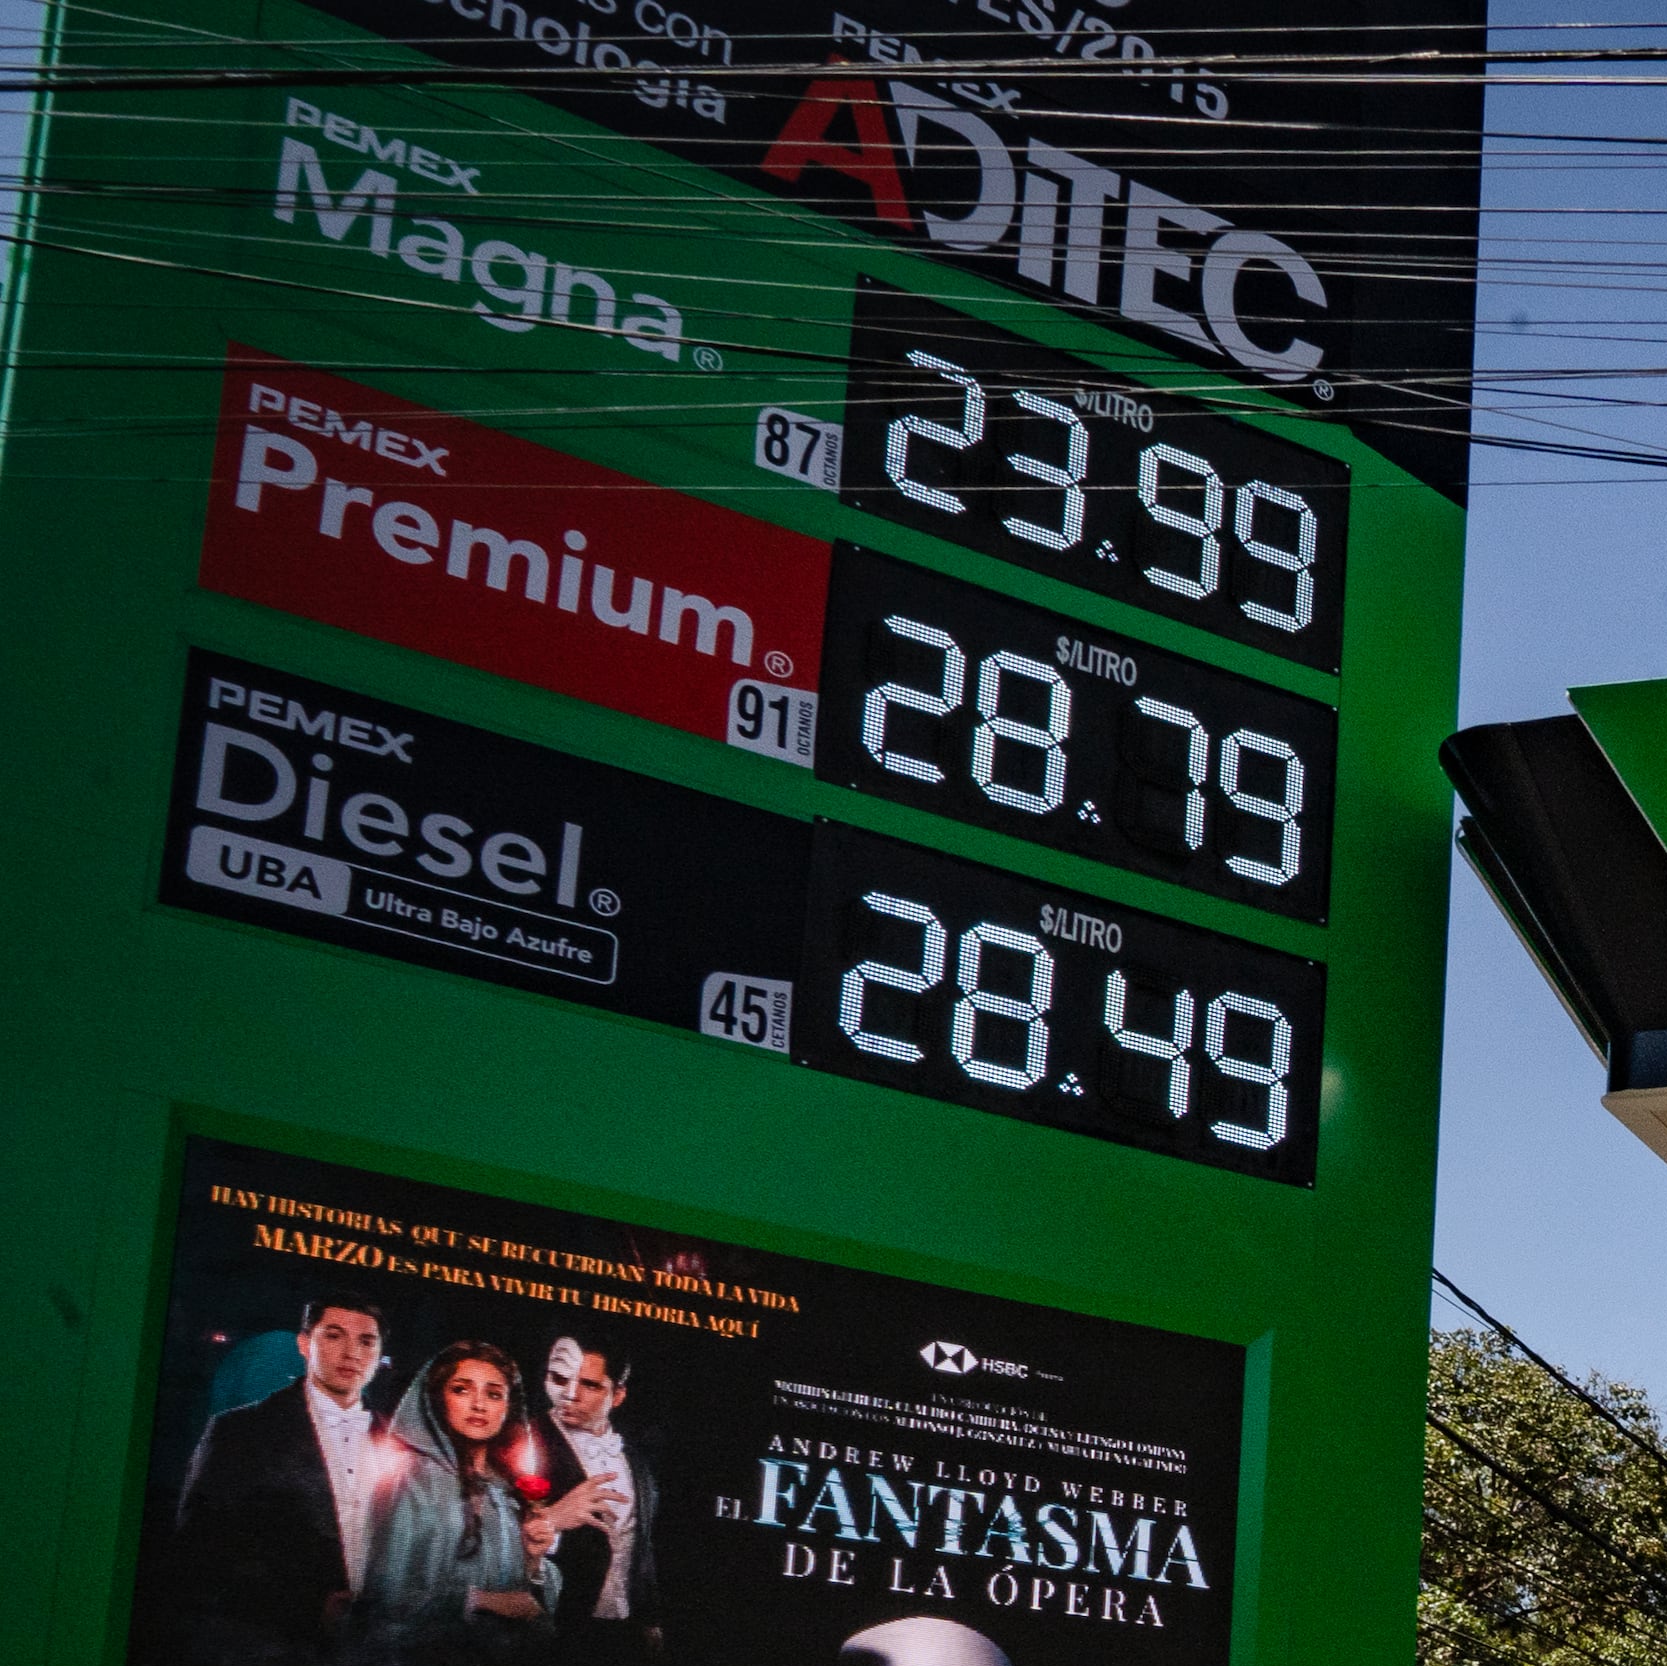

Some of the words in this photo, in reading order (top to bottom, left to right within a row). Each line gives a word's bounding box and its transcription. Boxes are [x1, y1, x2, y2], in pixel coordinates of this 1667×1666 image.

[832, 12, 1022, 119] PEEX
[286, 97, 482, 194] PEMEX
[273, 137, 681, 362] Magna
[249, 383, 450, 476] PEMEX
[764, 413, 821, 476] 87
[824, 432, 838, 487] OCTANOS
[885, 349, 1317, 633] 23.99
[235, 425, 756, 667] Premium
[1055, 635, 1139, 687] $/LITRO
[207, 677, 416, 764] PEMEX
[736, 685, 789, 749] 91
[797, 702, 814, 756] OCTANOS
[862, 614, 1305, 886] 28.79
[196, 722, 583, 908] Diesel
[219, 845, 322, 900] UBA
[365, 887, 432, 923] Ultra
[441, 908, 499, 942] Bajo
[506, 926, 594, 965] Azufre
[1039, 903, 1123, 954] $/LITRO
[709, 980, 769, 1045] 45
[771, 992, 788, 1049] CETANOS
[839, 891, 1293, 1152] 28.49
[211, 1184, 265, 1210] HAY
[268, 1195, 403, 1236] HISTORIAS
[468, 1236, 498, 1254] SE
[502, 1239, 646, 1283] RECUERDAN
[653, 1269, 713, 1298] TODA
[716, 1282, 743, 1302] LA
[748, 1287, 800, 1313] VIDA
[254, 1223, 385, 1269] MARZO
[387, 1255, 418, 1274] ES
[422, 1262, 486, 1289] PARA
[490, 1273, 553, 1301] VIVIR
[558, 1287, 586, 1306] TU
[592, 1293, 700, 1329] HISTORIA
[705, 1314, 760, 1338] AQUÍ
[981, 1357, 1029, 1379] HSBC
[767, 1434, 916, 1474] ANDREW
[935, 1461, 1041, 1494] LLOYD
[1062, 1481, 1190, 1518] WEBBER
[716, 1496, 748, 1521] EL
[753, 1458, 1211, 1589] FANTASMA
[783, 1542, 856, 1586] DE
[892, 1558, 956, 1600] LA
[987, 1565, 1165, 1628] ÓPERA
